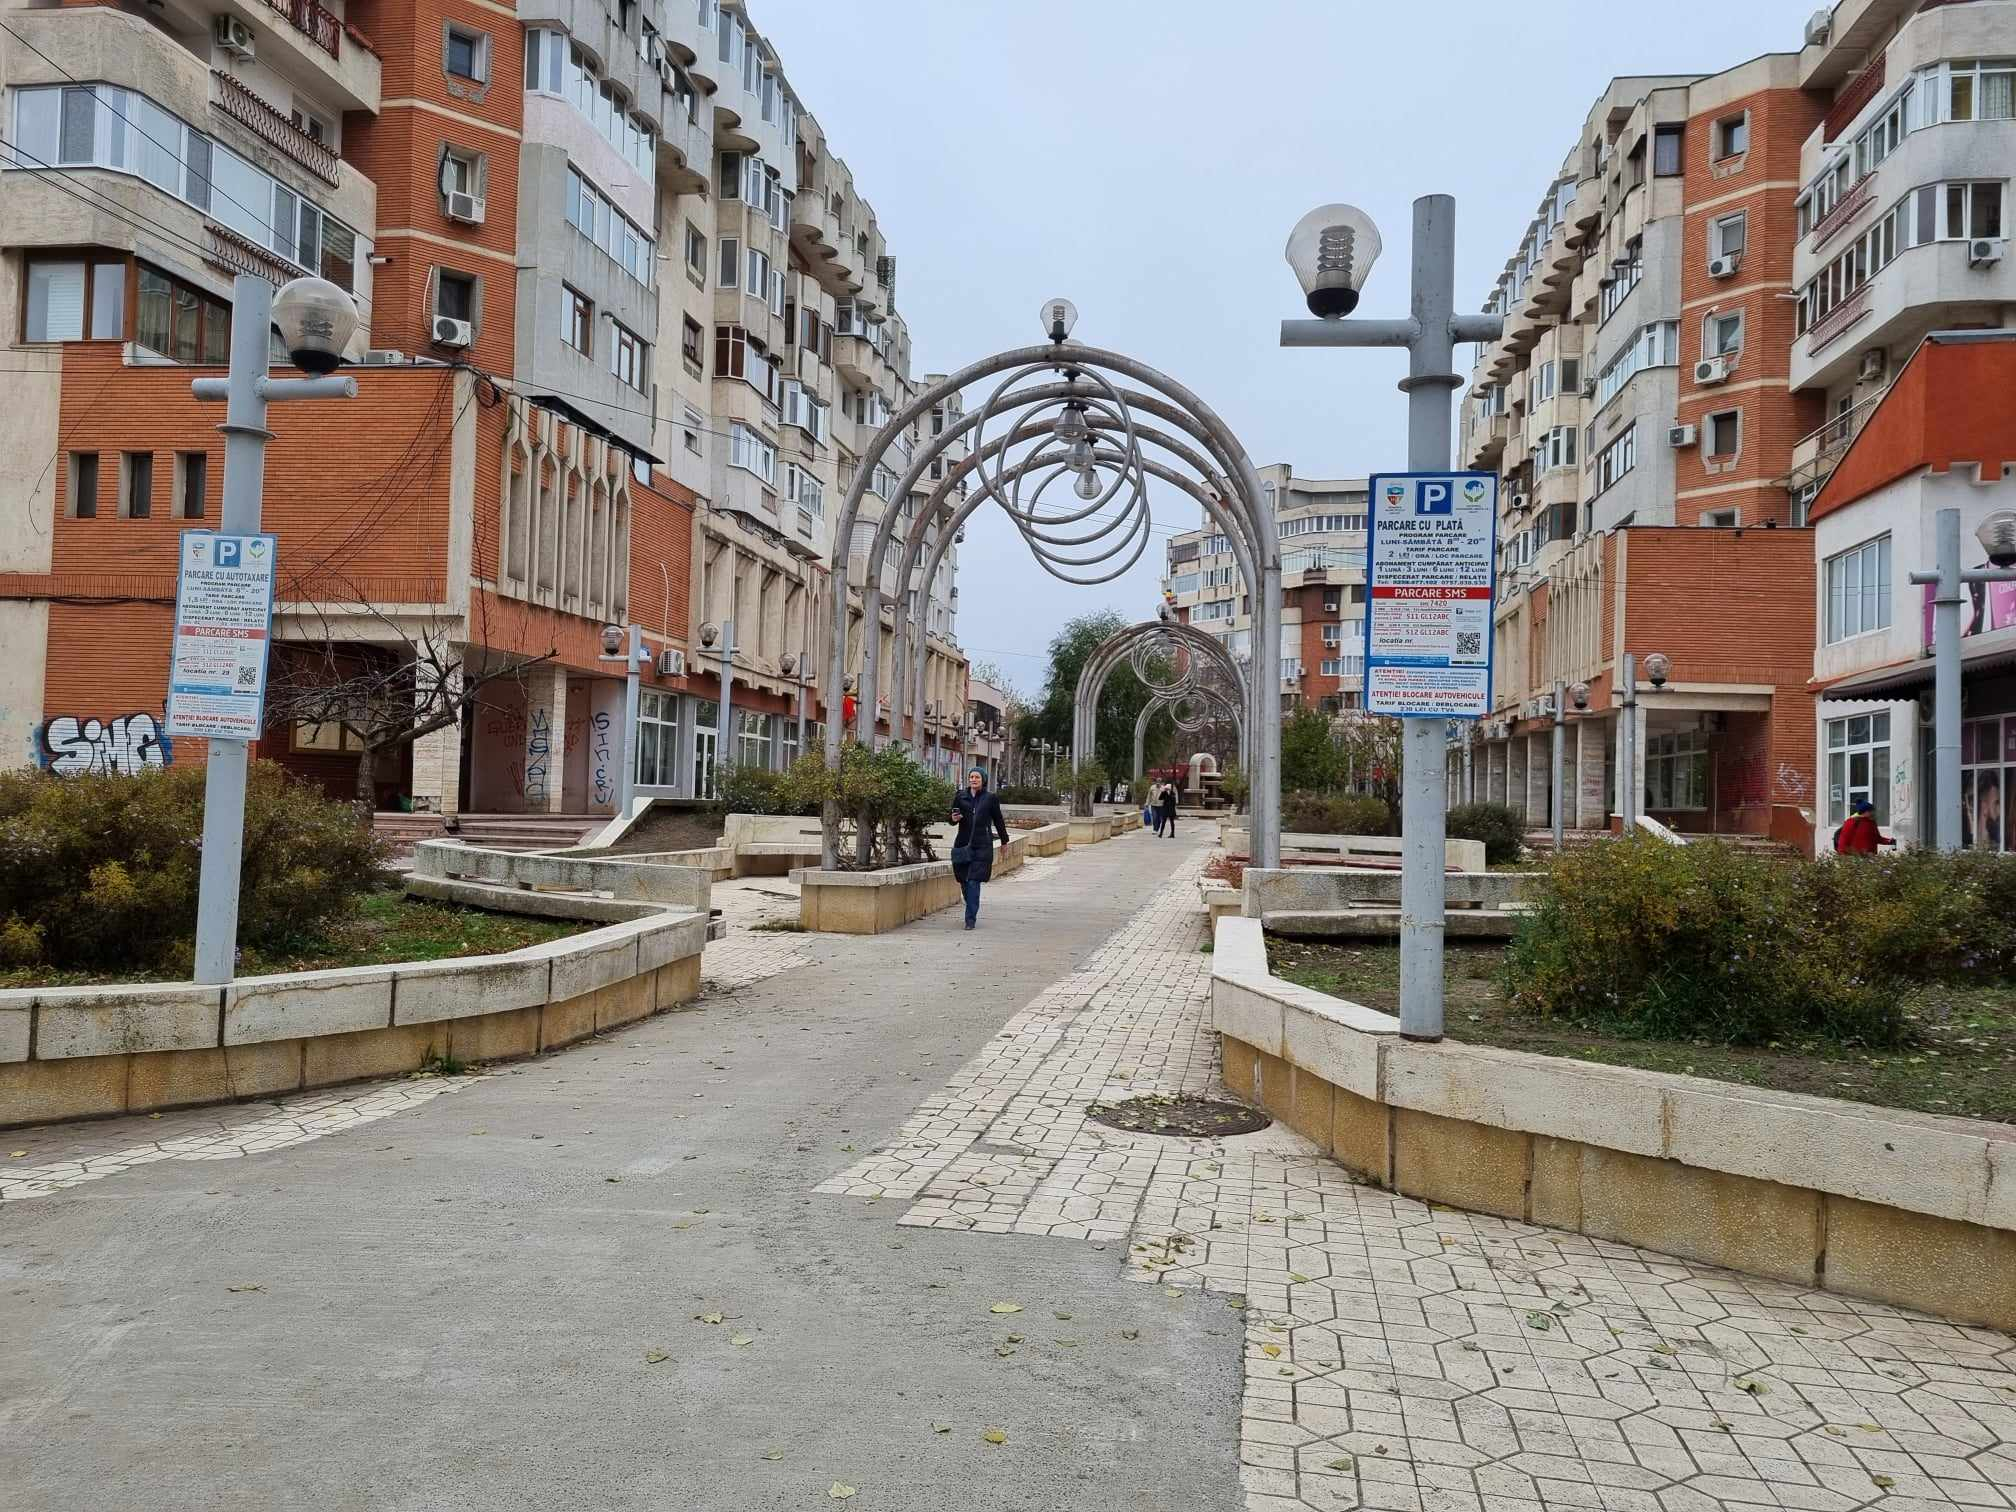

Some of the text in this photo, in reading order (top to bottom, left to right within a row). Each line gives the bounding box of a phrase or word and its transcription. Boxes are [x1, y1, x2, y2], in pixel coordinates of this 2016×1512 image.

[1424, 484, 1446, 512] P
[1377, 518, 1464, 531] PARCARE CU PLATĂ
[220, 542, 237, 564] P
[184, 570, 270, 582] PARCARE CU AUTOTAXARE
[1394, 588, 1467, 598] PARCARE SMS
[194, 627, 249, 638] PARCARE SMS
